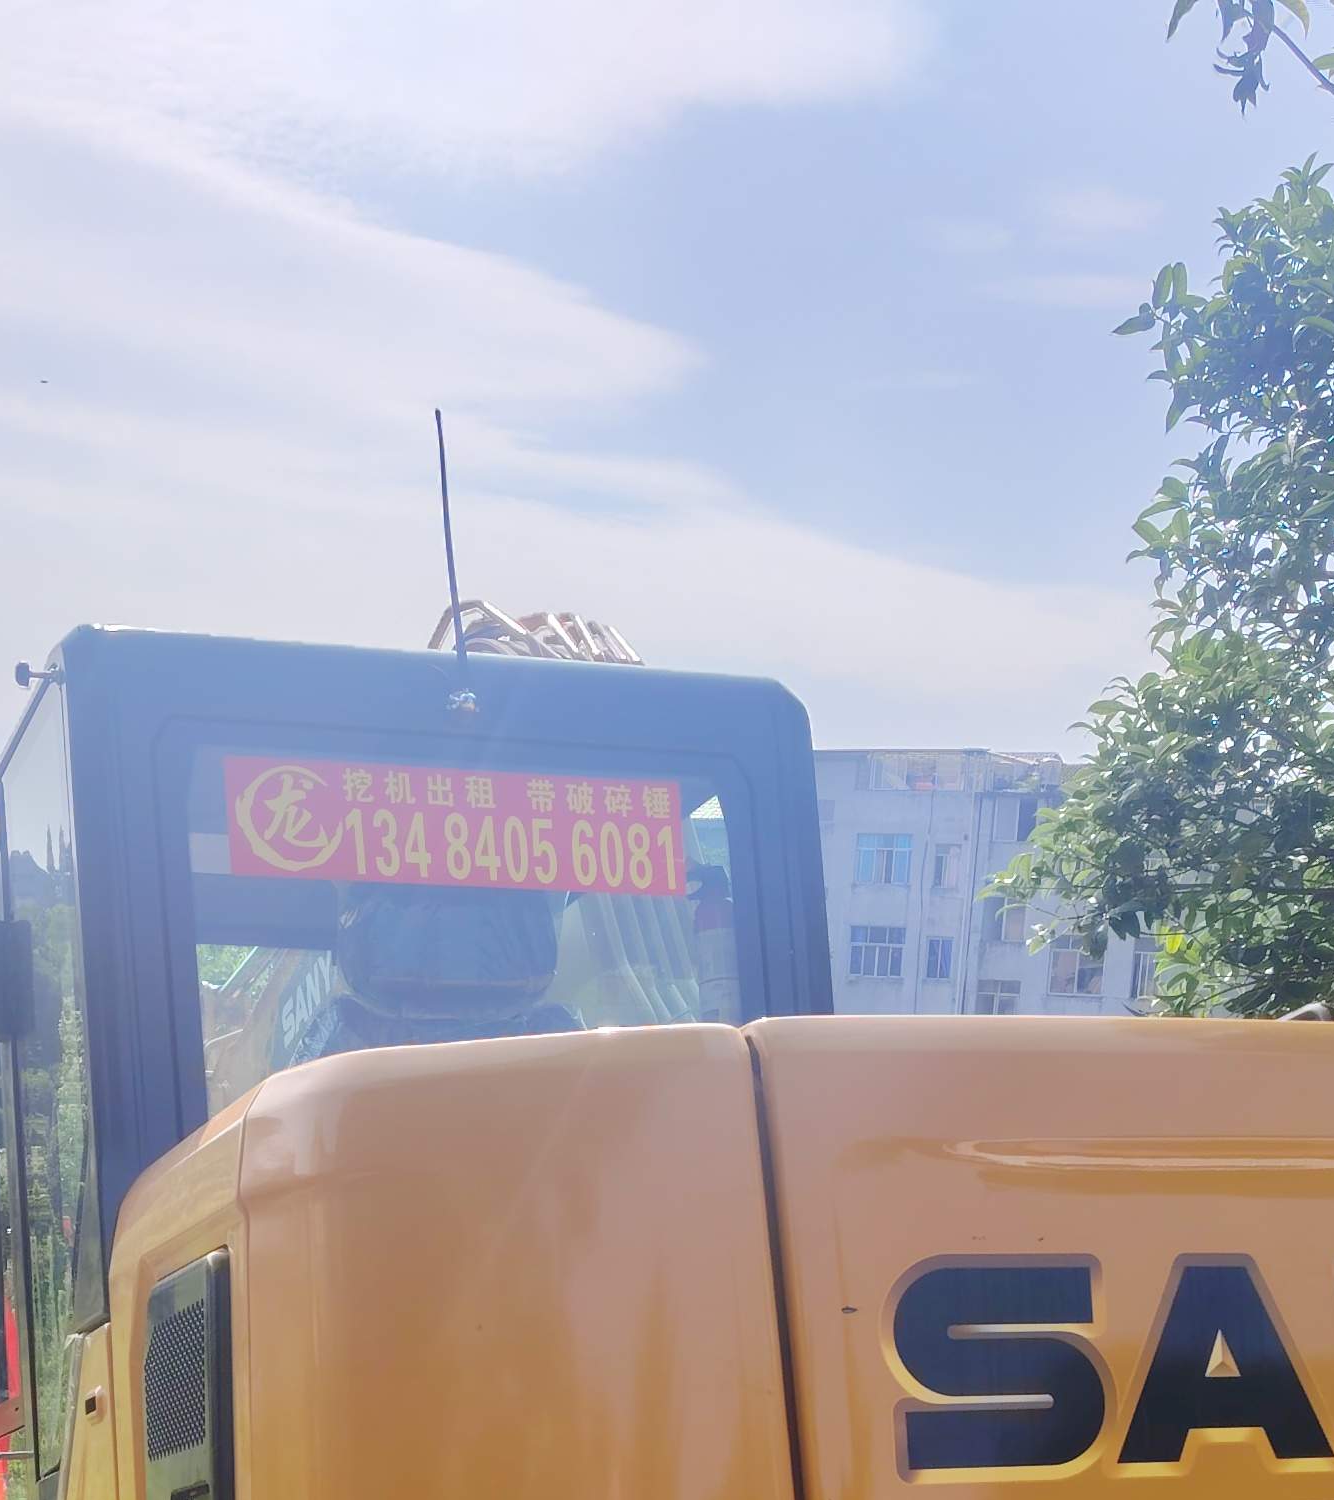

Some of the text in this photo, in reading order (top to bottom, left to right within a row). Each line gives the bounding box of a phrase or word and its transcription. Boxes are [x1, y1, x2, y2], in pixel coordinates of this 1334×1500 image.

[343, 767, 671, 820] 挖机出租 带破碎锤
[345, 808, 676, 890] 134 8405 6081
[282, 950, 332, 1048] SANY
